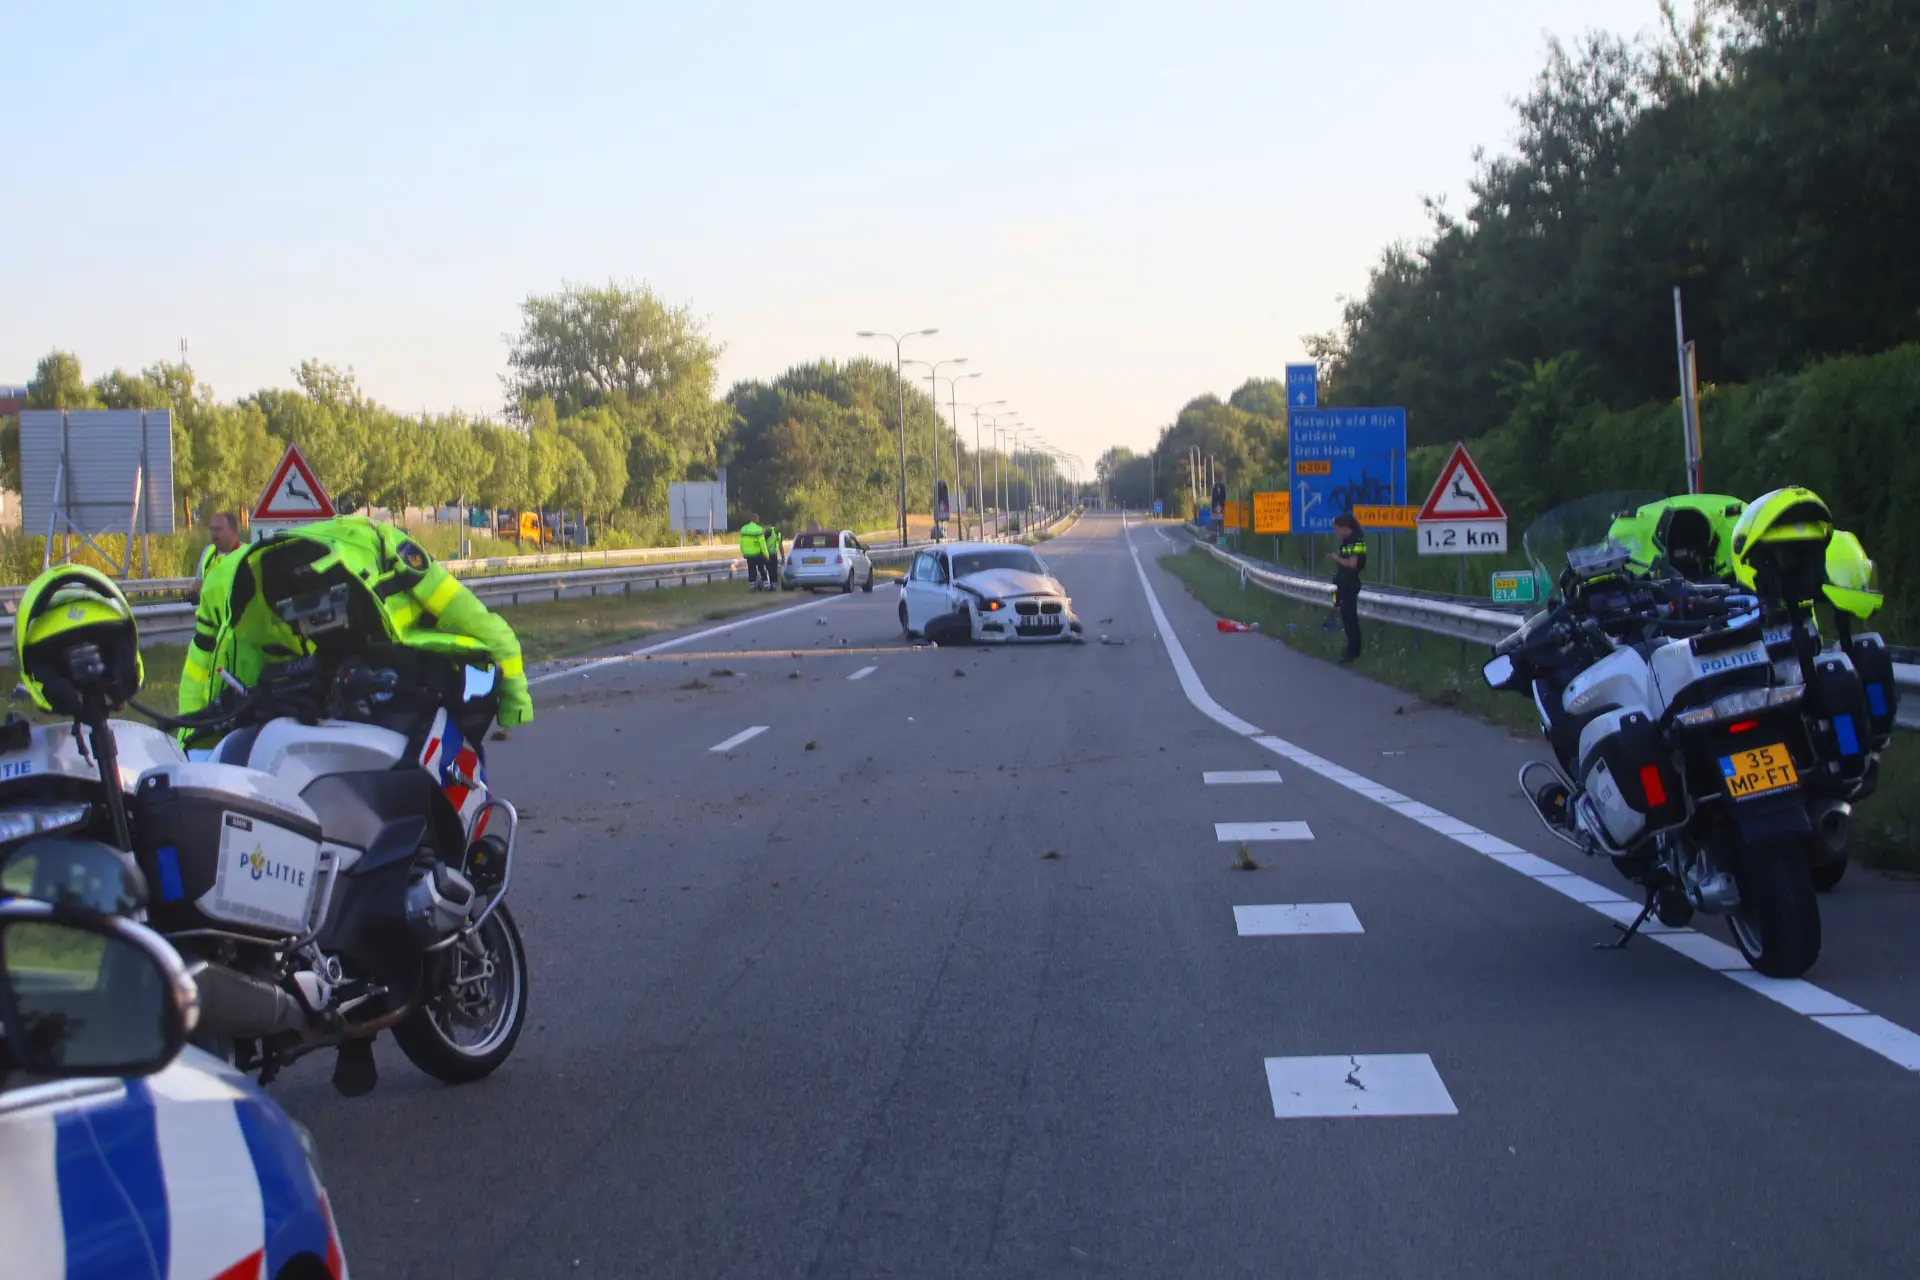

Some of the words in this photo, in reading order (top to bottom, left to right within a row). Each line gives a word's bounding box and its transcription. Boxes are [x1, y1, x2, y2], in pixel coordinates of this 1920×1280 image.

[1295, 415, 1342, 429] Katwijk
[1346, 415, 1366, 427] a/d
[1371, 414, 1396, 429] Rijn
[1294, 430, 1337, 442] Leiden
[1294, 445, 1319, 457] Den
[1324, 445, 1355, 459] Haag
[1425, 529, 1457, 548] 1,2
[1466, 528, 1500, 546] km
[1495, 589, 1517, 600] 21,4
[1700, 650, 1760, 674] POLITIE
[1746, 748, 1774, 769] 35
[232, 817, 248, 829] BMW
[239, 851, 306, 888] POLITIE
